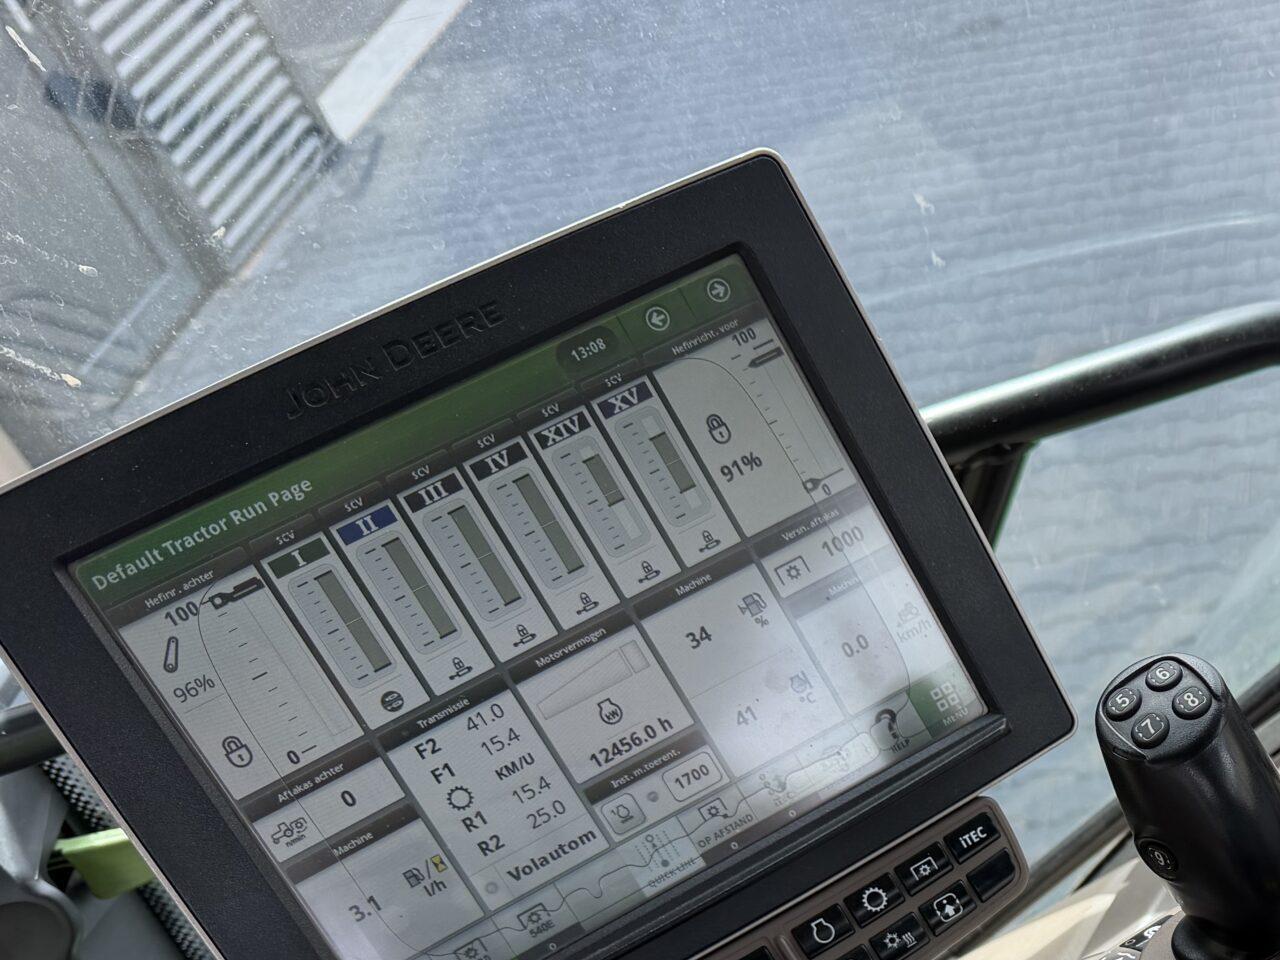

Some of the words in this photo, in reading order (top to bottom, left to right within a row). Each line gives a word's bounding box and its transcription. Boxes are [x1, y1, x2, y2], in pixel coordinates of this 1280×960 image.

[570, 337, 607, 362] 13:08
[731, 327, 757, 348] 100
[287, 356, 383, 420] JOHN
[382, 300, 507, 372] DEERE
[541, 403, 560, 419] SCV
[607, 386, 641, 413] XV
[477, 433, 496, 449] SCV
[542, 415, 581, 446] XIV
[411, 465, 430, 480] SCV
[484, 449, 511, 474] IV
[720, 450, 764, 484] 91%
[344, 497, 364, 512] SCV
[418, 481, 450, 506] III
[91, 550, 164, 591] Default
[162, 517, 229, 557] Tractor
[229, 501, 268, 526] Run
[268, 478, 313, 508] Page
[275, 530, 296, 545] SCV
[355, 515, 380, 536] II
[821, 526, 865, 558] 1000
[183, 570, 214, 592] achter
[675, 572, 713, 596] Machine
[164, 602, 199, 627] 100
[535, 627, 607, 668] Motorvermogen
[685, 626, 713, 650] 34
[841, 633, 870, 658] 0.0
[1155, 667, 1170, 680] 6
[173, 674, 216, 704] 96%
[1115, 693, 1130, 708] 5
[1183, 692, 1199, 707] 8
[417, 697, 471, 729] Transmissie
[735, 705, 757, 728] 41
[414, 737, 442, 760] F2
[466, 703, 506, 732] 41.0
[1141, 718, 1156, 734] 7
[589, 724, 657, 768] 12456.0
[657, 716, 674, 733] h
[286, 750, 300, 765] 0
[430, 762, 457, 784] F1
[481, 727, 521, 756] 15.4
[495, 752, 536, 781] KM/U
[314, 763, 344, 784] achter
[674, 764, 711, 790] 1700
[340, 790, 357, 807] 0
[461, 810, 489, 833] R1
[512, 775, 553, 805] 15.4
[477, 834, 506, 857] R2
[526, 799, 567, 830] 25.0
[332, 831, 374, 857] Machine
[506, 828, 597, 882] Volautom
[697, 836, 712, 849] OP
[424, 879, 448, 897] l/h
[348, 895, 382, 922] 3.1
